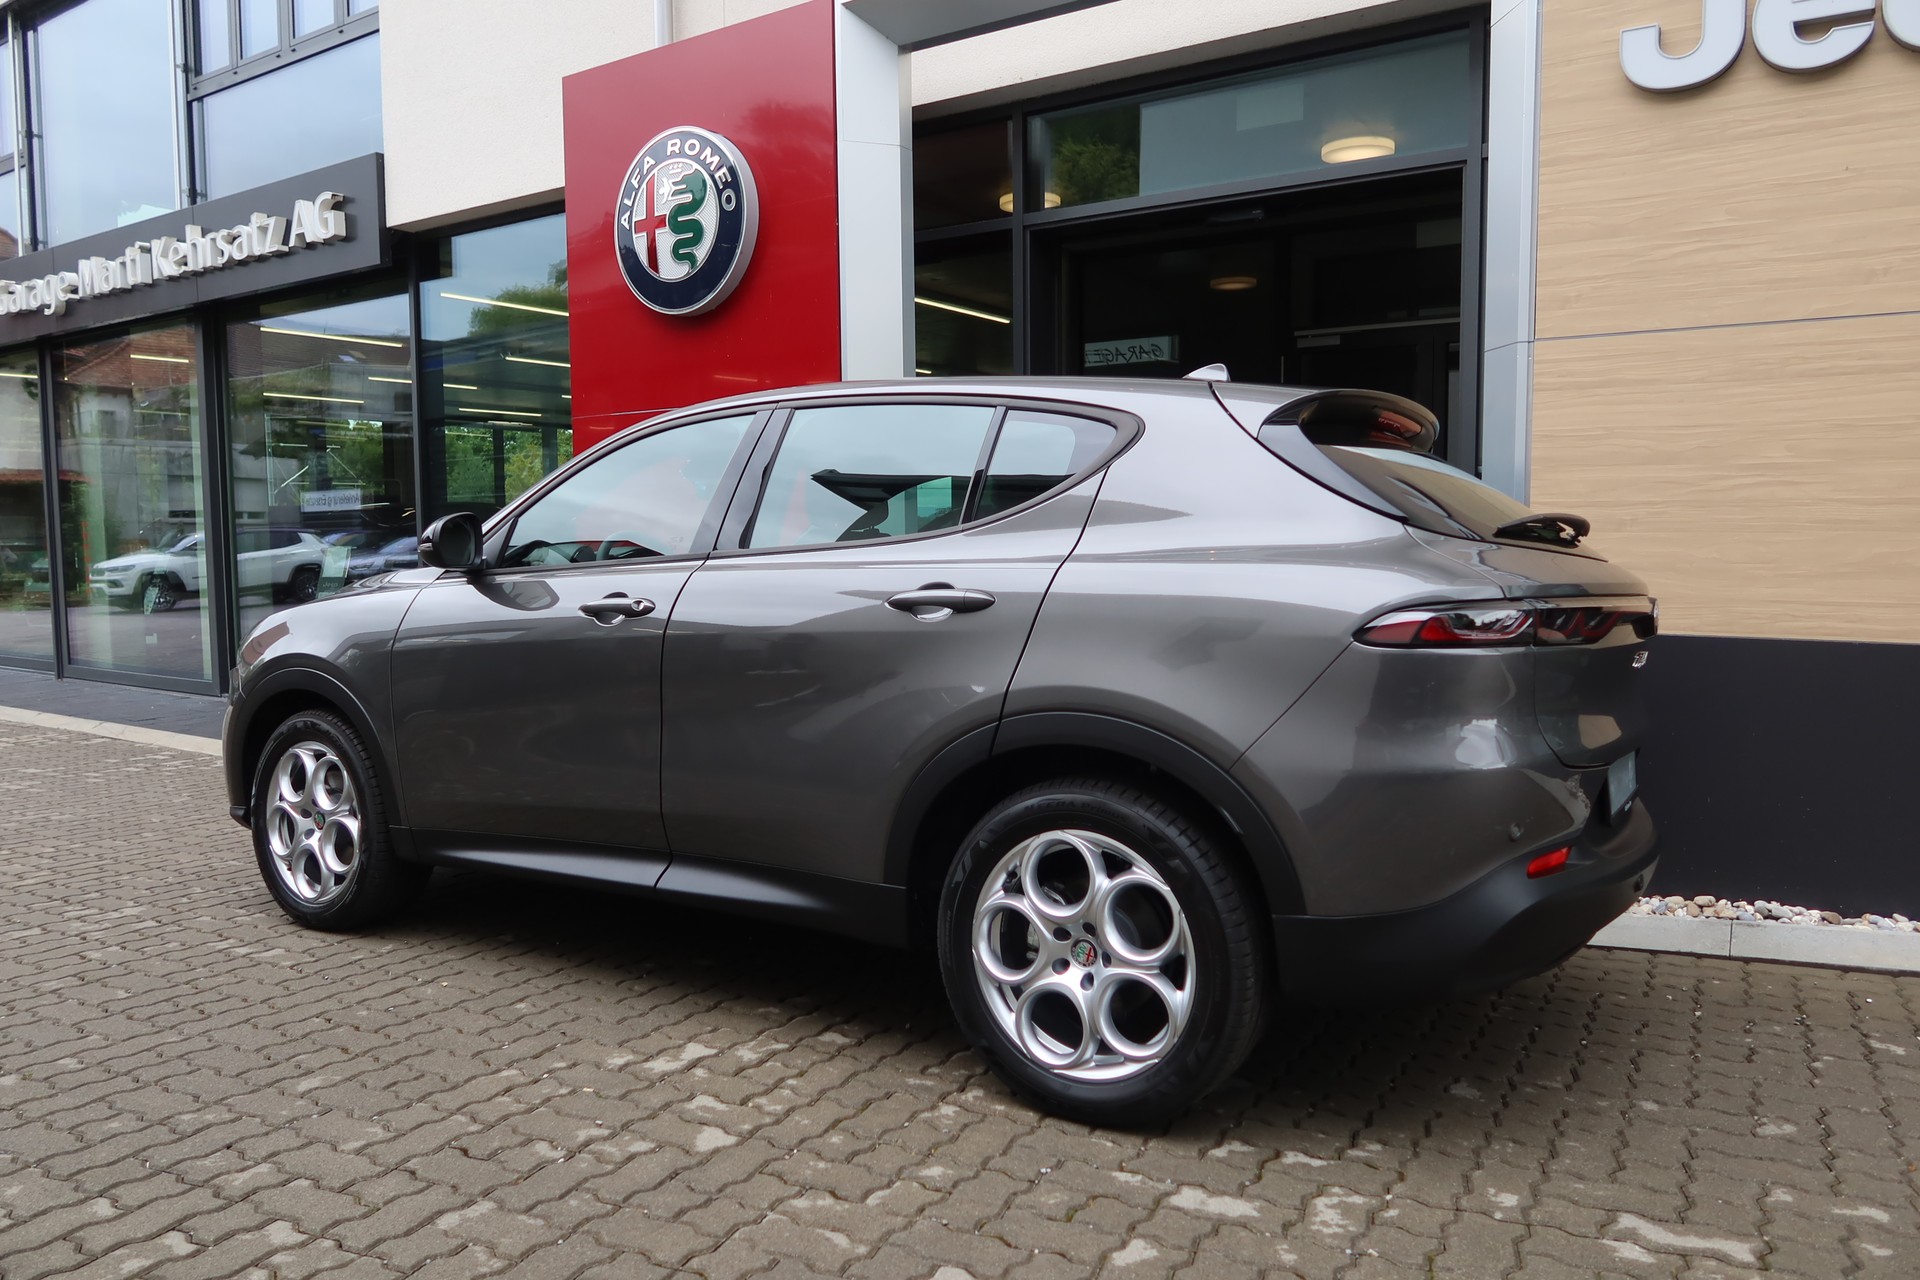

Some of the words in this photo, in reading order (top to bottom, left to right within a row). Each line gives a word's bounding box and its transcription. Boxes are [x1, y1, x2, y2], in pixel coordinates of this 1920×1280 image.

[620, 155, 657, 230] ALFA
[666, 138, 737, 212] ROMEO
[78, 241, 152, 298] Marti
[151, 212, 289, 281] Kehrsatz
[289, 191, 347, 249] AG
